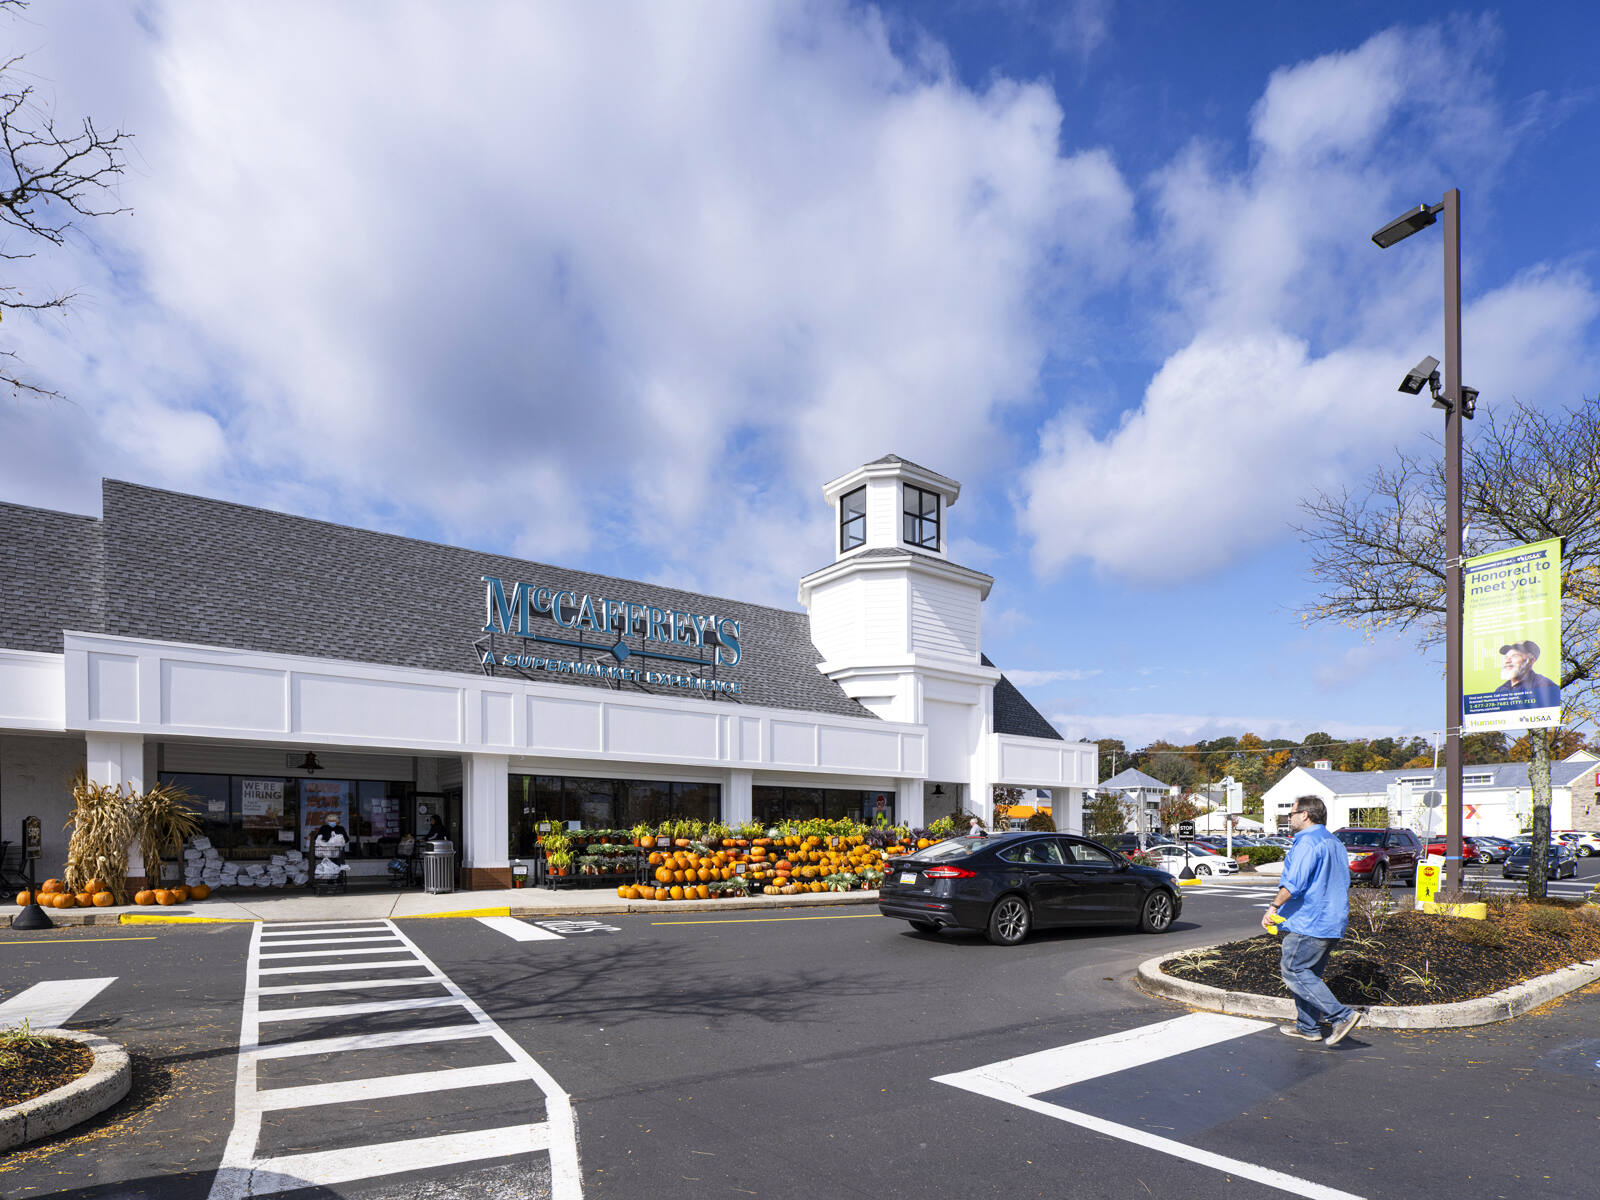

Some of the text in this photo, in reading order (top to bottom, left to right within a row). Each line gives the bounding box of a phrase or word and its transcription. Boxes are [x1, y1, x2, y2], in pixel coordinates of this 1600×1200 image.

[1471, 561, 1551, 584] Honored to
[1471, 576, 1541, 595] meet you.
[482, 651, 742, 694] A SUPERMARKET EXPERIENCE
[1530, 715, 1552, 723] USAA
[244, 782, 276, 791] WE'RE
[244, 791, 282, 799] HIRING
